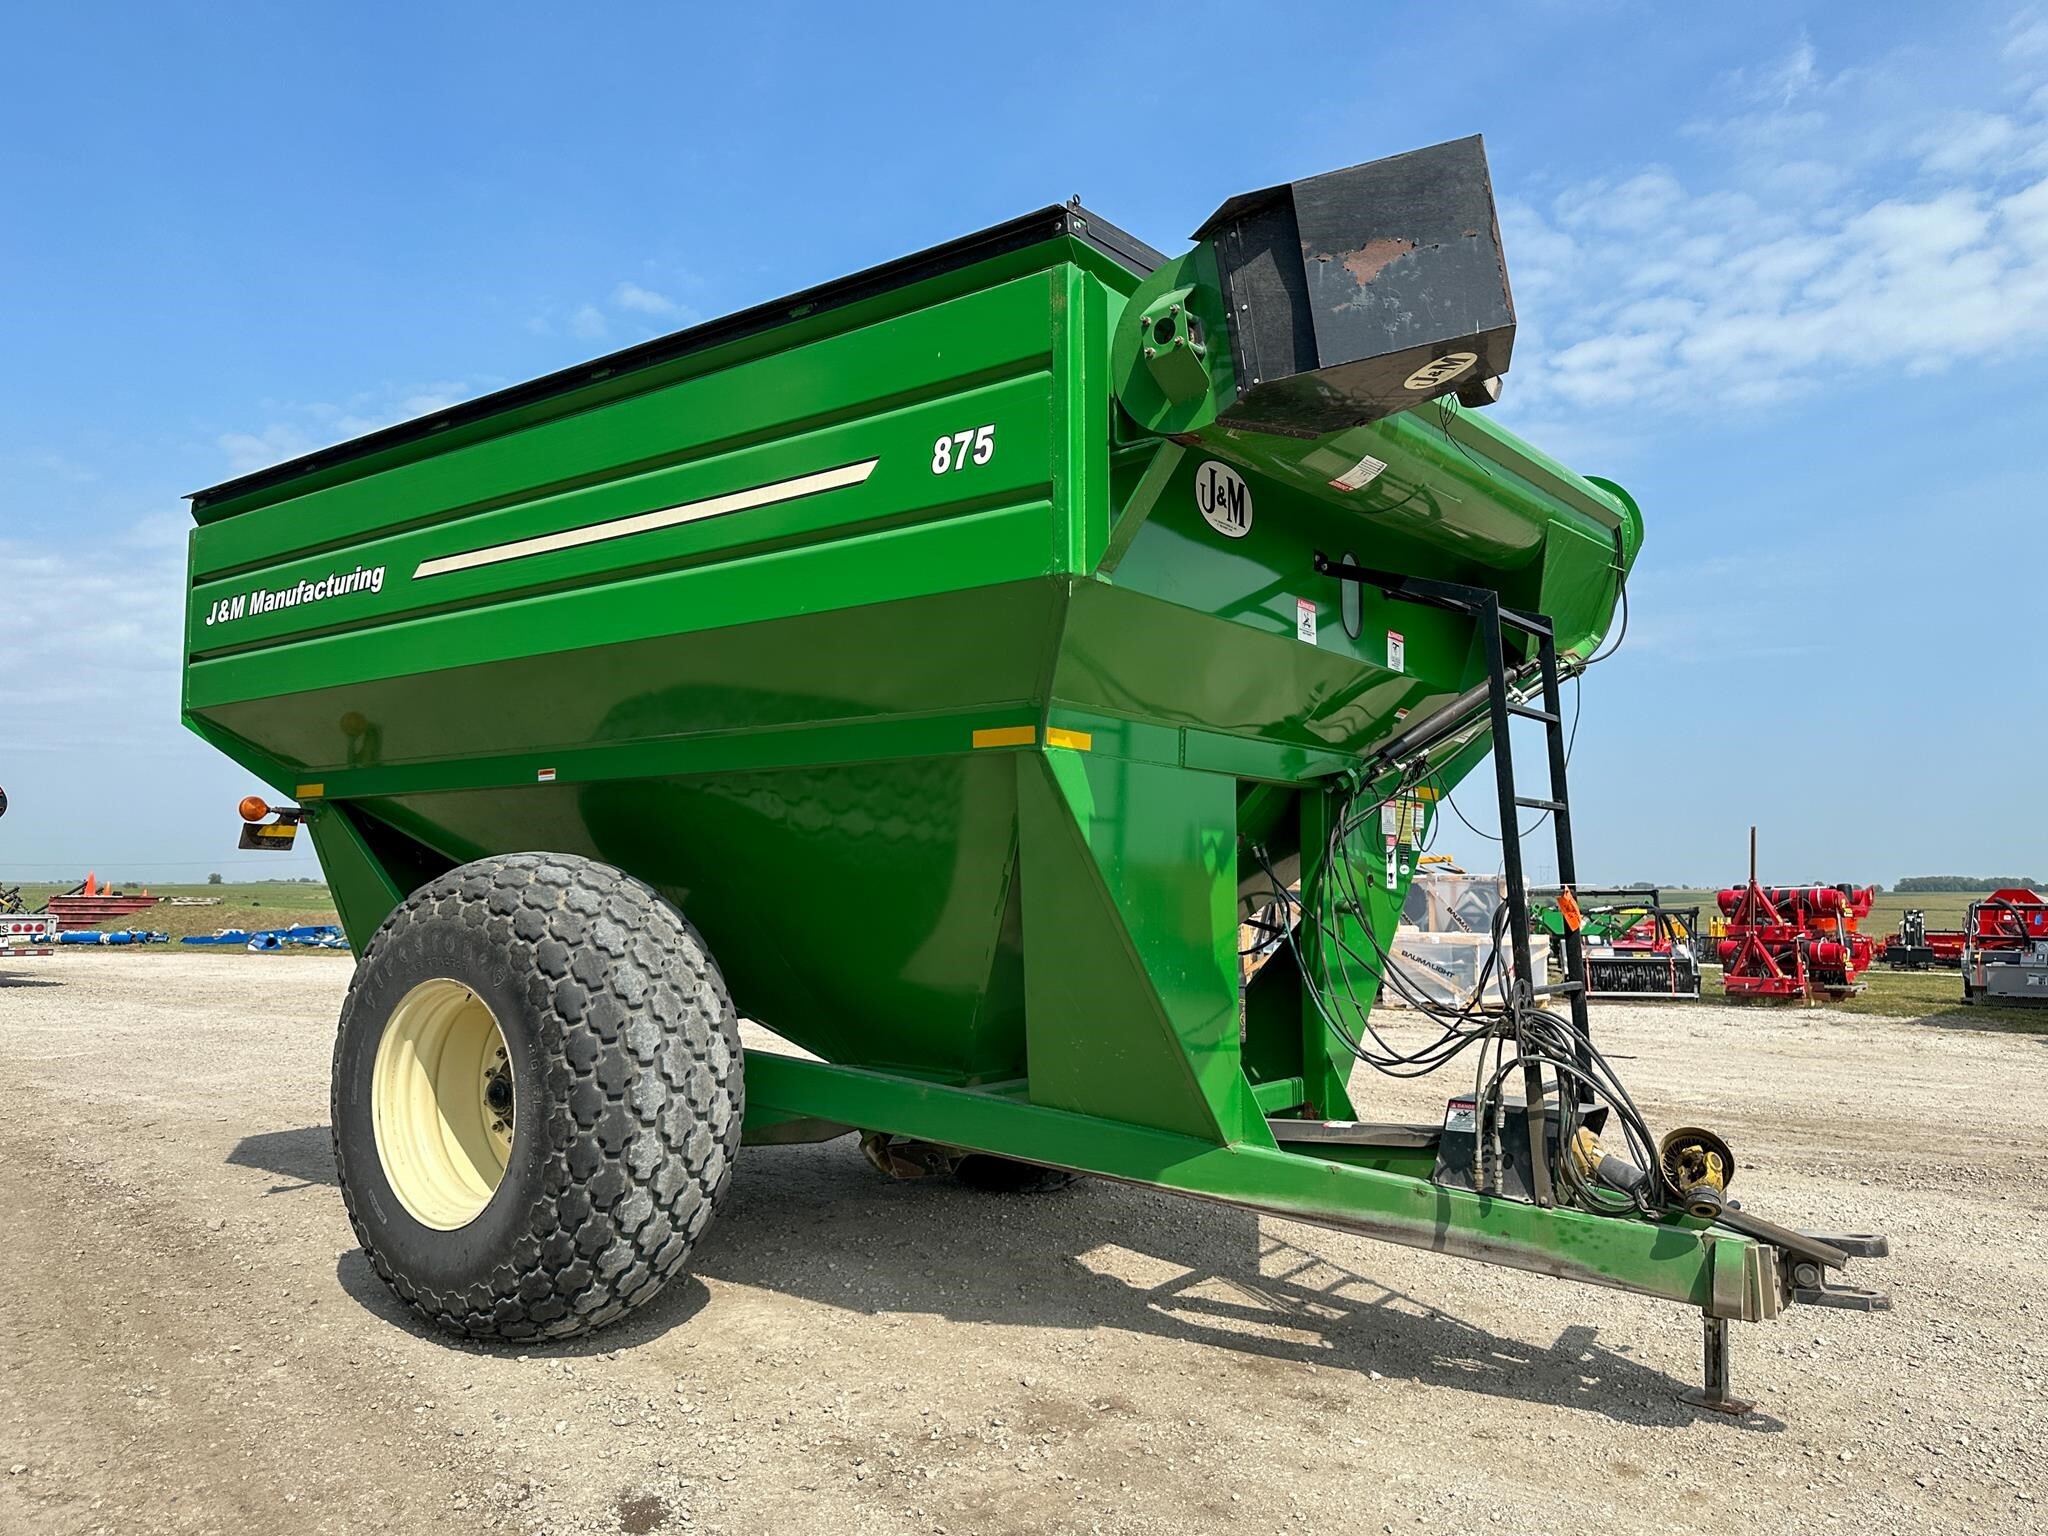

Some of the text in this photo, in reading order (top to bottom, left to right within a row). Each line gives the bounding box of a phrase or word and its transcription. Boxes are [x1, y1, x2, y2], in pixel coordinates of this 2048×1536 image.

[1410, 357, 1472, 387] J&M
[931, 423, 996, 475] 875
[1199, 466, 1246, 529] J&M
[205, 565, 386, 626] J&M Manufacturing
[1401, 950, 1455, 978] BAUMALIGHT
